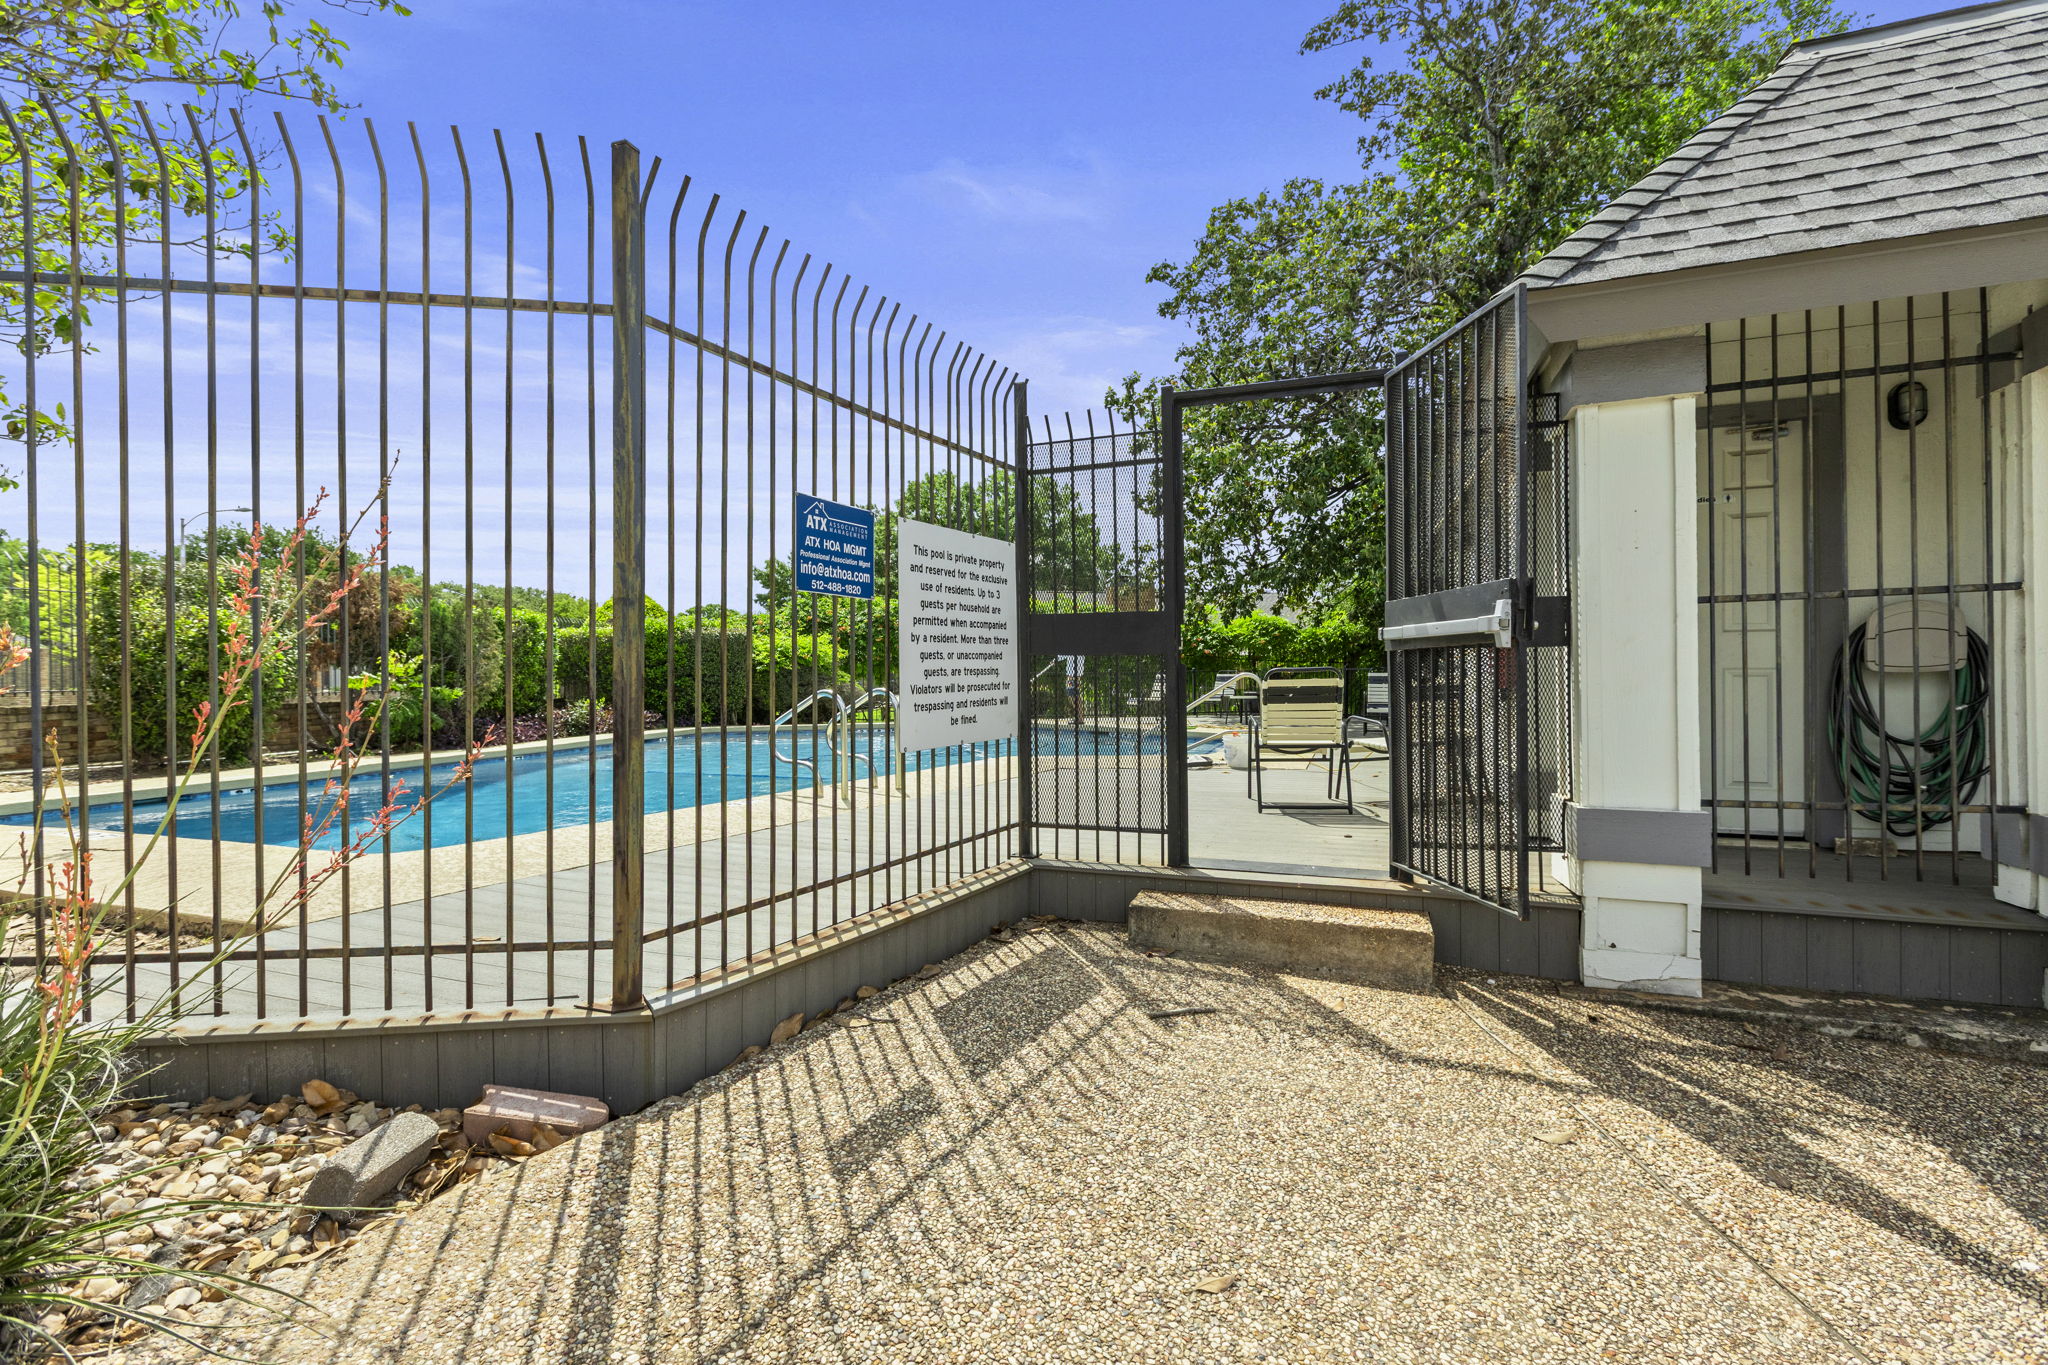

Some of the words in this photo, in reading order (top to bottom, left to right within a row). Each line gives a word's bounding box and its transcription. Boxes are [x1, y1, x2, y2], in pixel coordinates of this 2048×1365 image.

[806, 515, 827, 532] ATX
[829, 522, 868, 534] ASSOCIATION
[829, 528, 868, 540] MANAGEMENT
[805, 536, 820, 548] ATX
[824, 539, 840, 552] HOA
[844, 543, 866, 556] MGMT
[800, 550, 830, 560] Professional
[831, 556, 857, 565] Association
[913, 544, 928, 557] This
[931, 548, 945, 560] pool
[947, 551, 952, 560] is
[955, 552, 977, 566] private
[979, 558, 1004, 571] property
[800, 560, 870, 583] info@atxhoa.com
[910, 563, 923, 574] and
[926, 565, 955, 578] reserved
[958, 569, 966, 579] for
[970, 571, 979, 581] the
[982, 572, 1008, 585] exclusive
[936, 582, 942, 592] of
[945, 584, 975, 596] residents.
[978, 587, 985, 599] Up
[988, 589, 994, 599] to
[996, 590, 1000, 599] 3
[920, 600, 943, 612] guests
[946, 603, 957, 612] per
[959, 601, 989, 614] household
[992, 606, 1001, 614] are
[913, 616, 947, 628] permitted
[950, 618, 967, 628] when
[970, 620, 1007, 630] accompanied
[911, 632, 920, 645] by
[930, 633, 958, 644] resident.
[960, 635, 976, 644] More
[978, 636, 991, 645] than
[994, 636, 1008, 645] three
[920, 651, 945, 662] guests,
[947, 651, 954, 659] or
[957, 651, 1002, 661] unaccompanied
[924, 668, 948, 678] guests,
[964, 667, 1000, 677] trespassing.
[910, 683, 942, 695] Violators
[945, 683, 955, 693] will
[958, 683, 965, 692] be
[967, 682, 1000, 694] prosecuted
[914, 700, 954, 713] trespassing
[956, 699, 967, 708] and
[970, 696, 997, 707] residents
[999, 695, 1008, 705] will
[951, 716, 958, 725] be
[961, 714, 978, 724] fined.
